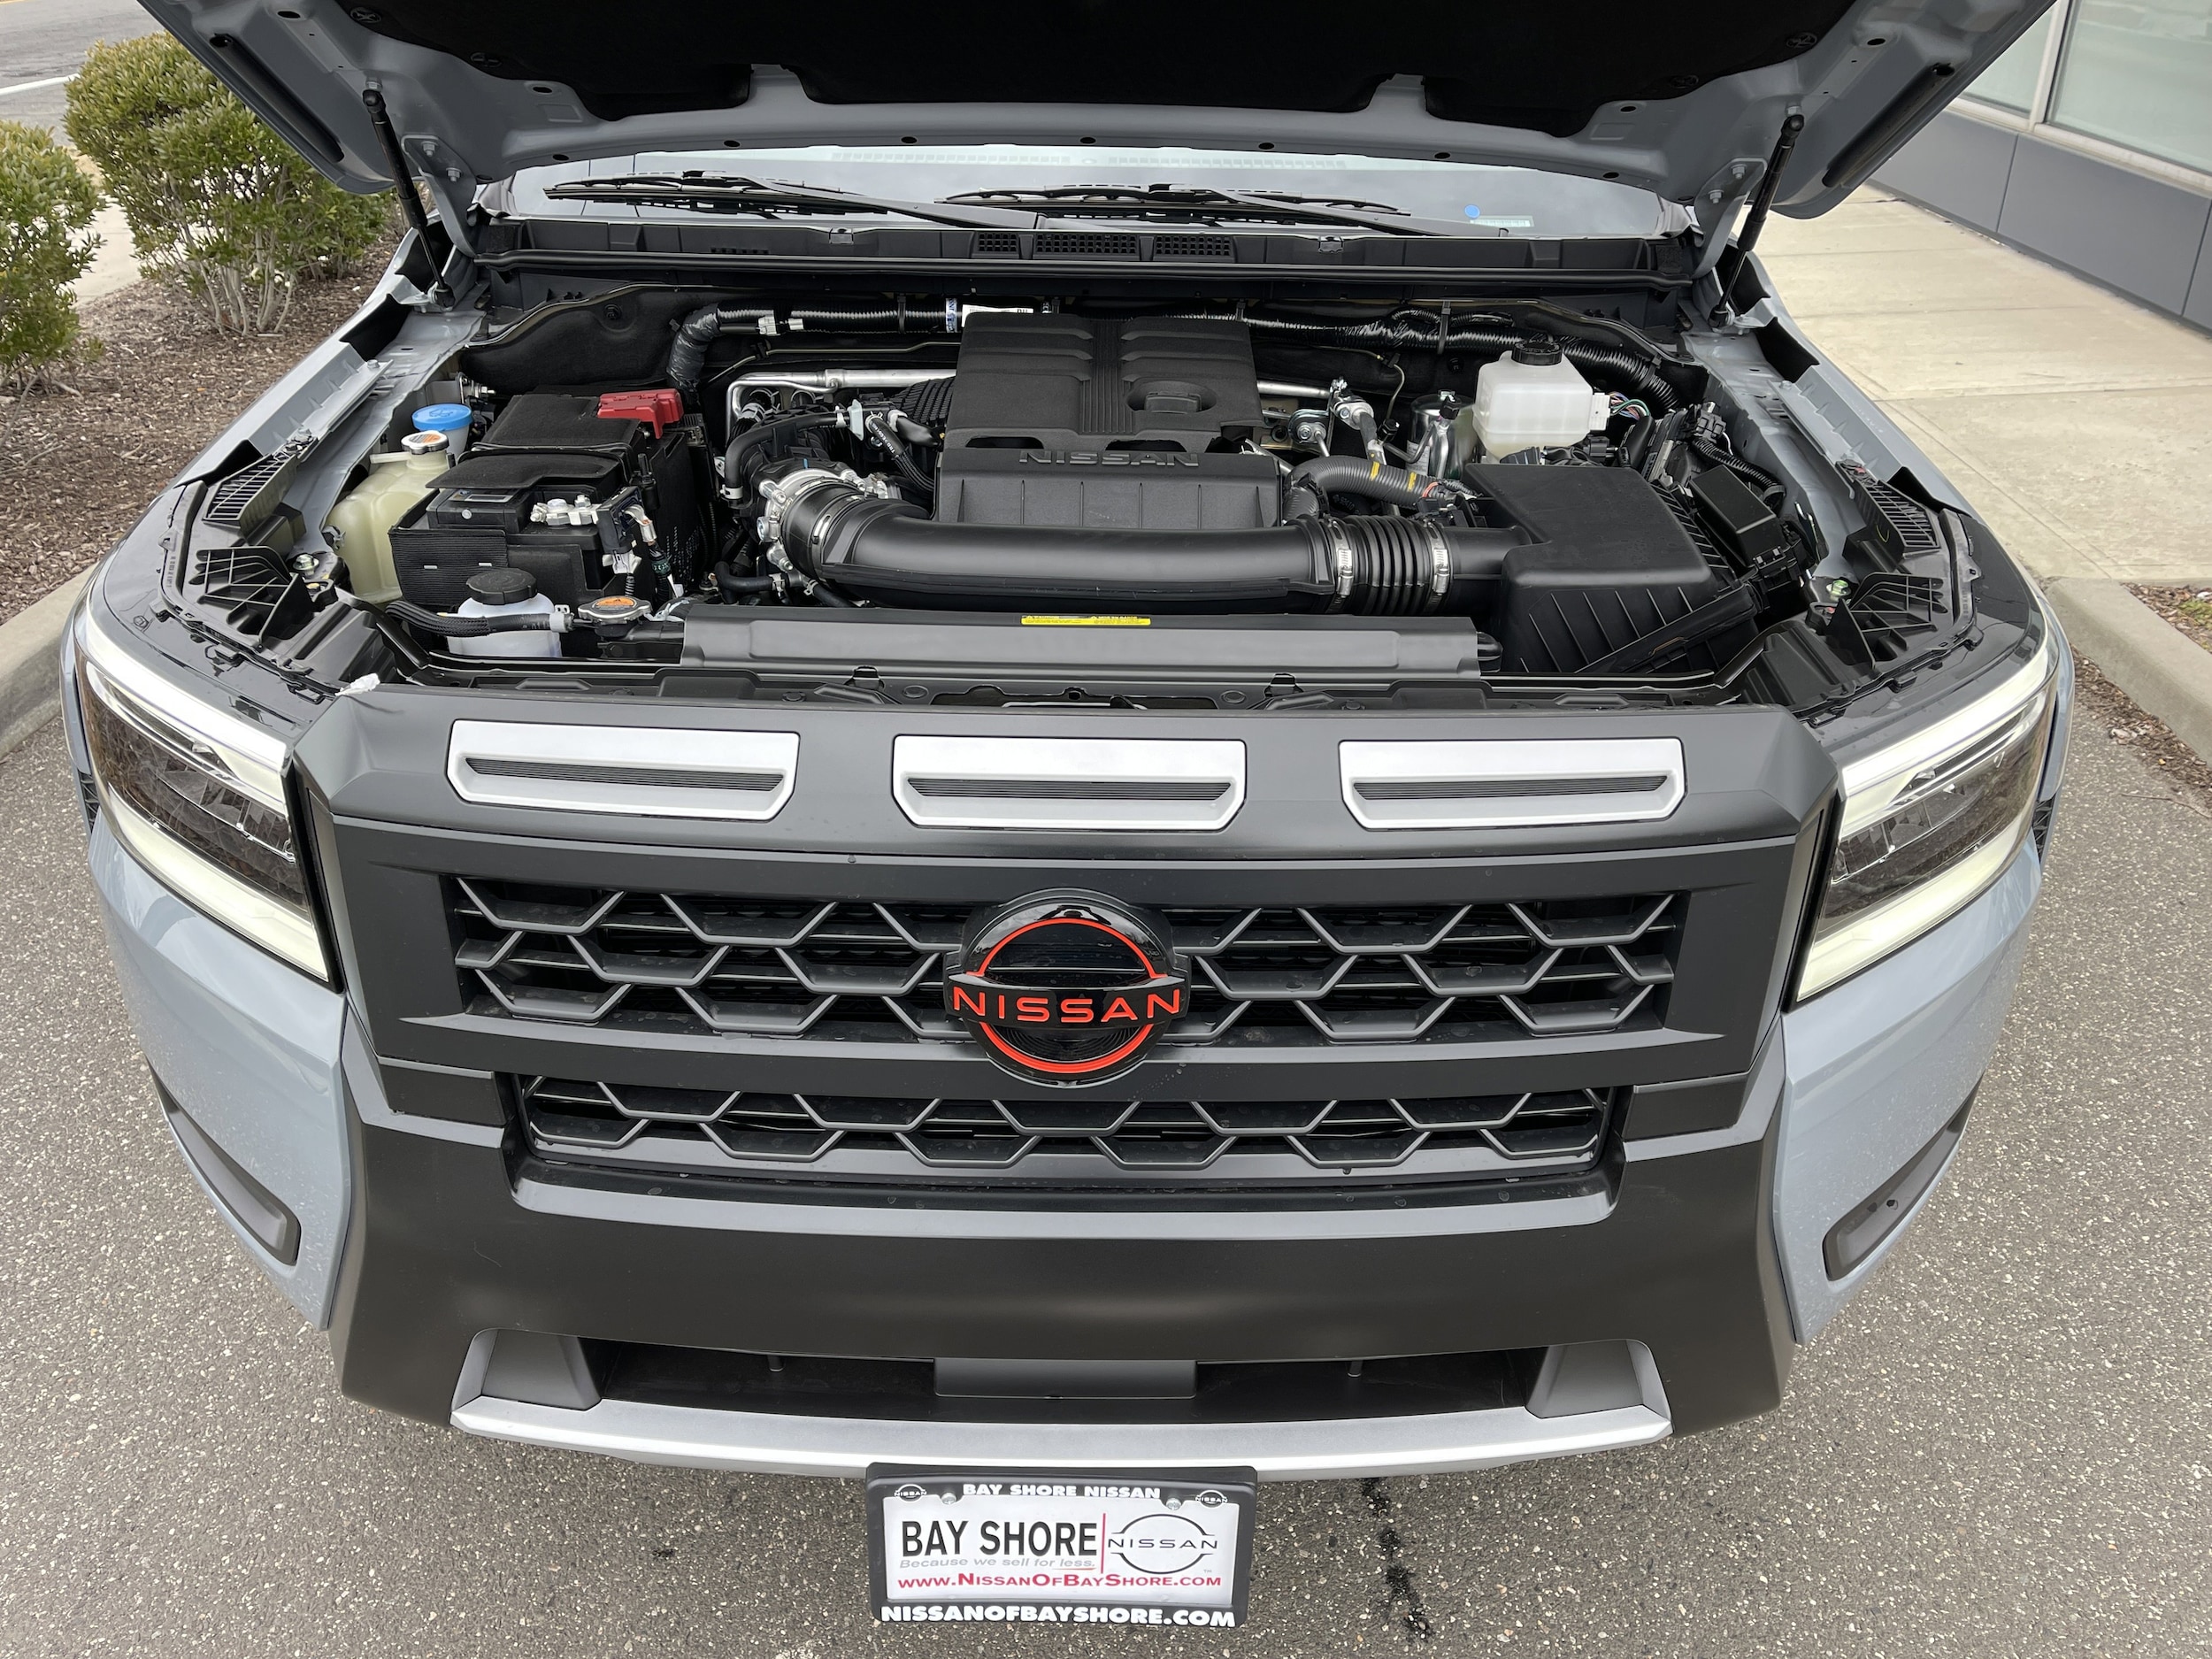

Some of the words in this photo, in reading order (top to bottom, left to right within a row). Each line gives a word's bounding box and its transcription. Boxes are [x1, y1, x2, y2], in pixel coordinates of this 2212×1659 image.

[1018, 449, 1199, 466] NISSAN
[953, 986, 1180, 1023] NISSAN
[963, 1484, 1002, 1495] BAY
[1010, 1485, 1077, 1496] SHORE
[1084, 1486, 1161, 1498] NISSAN
[902, 1520, 969, 1556] BAY
[979, 1520, 1097, 1556] SHORE
[1108, 1539, 1217, 1549] NISSAN
[900, 1558, 968, 1569] Because
[1002, 1558, 1029, 1567] sell
[1034, 1558, 1056, 1568] for
[1060, 1558, 1095, 1568] less.
[880, 1605, 1236, 1627] NISSANOFBAYSHORE.COM
